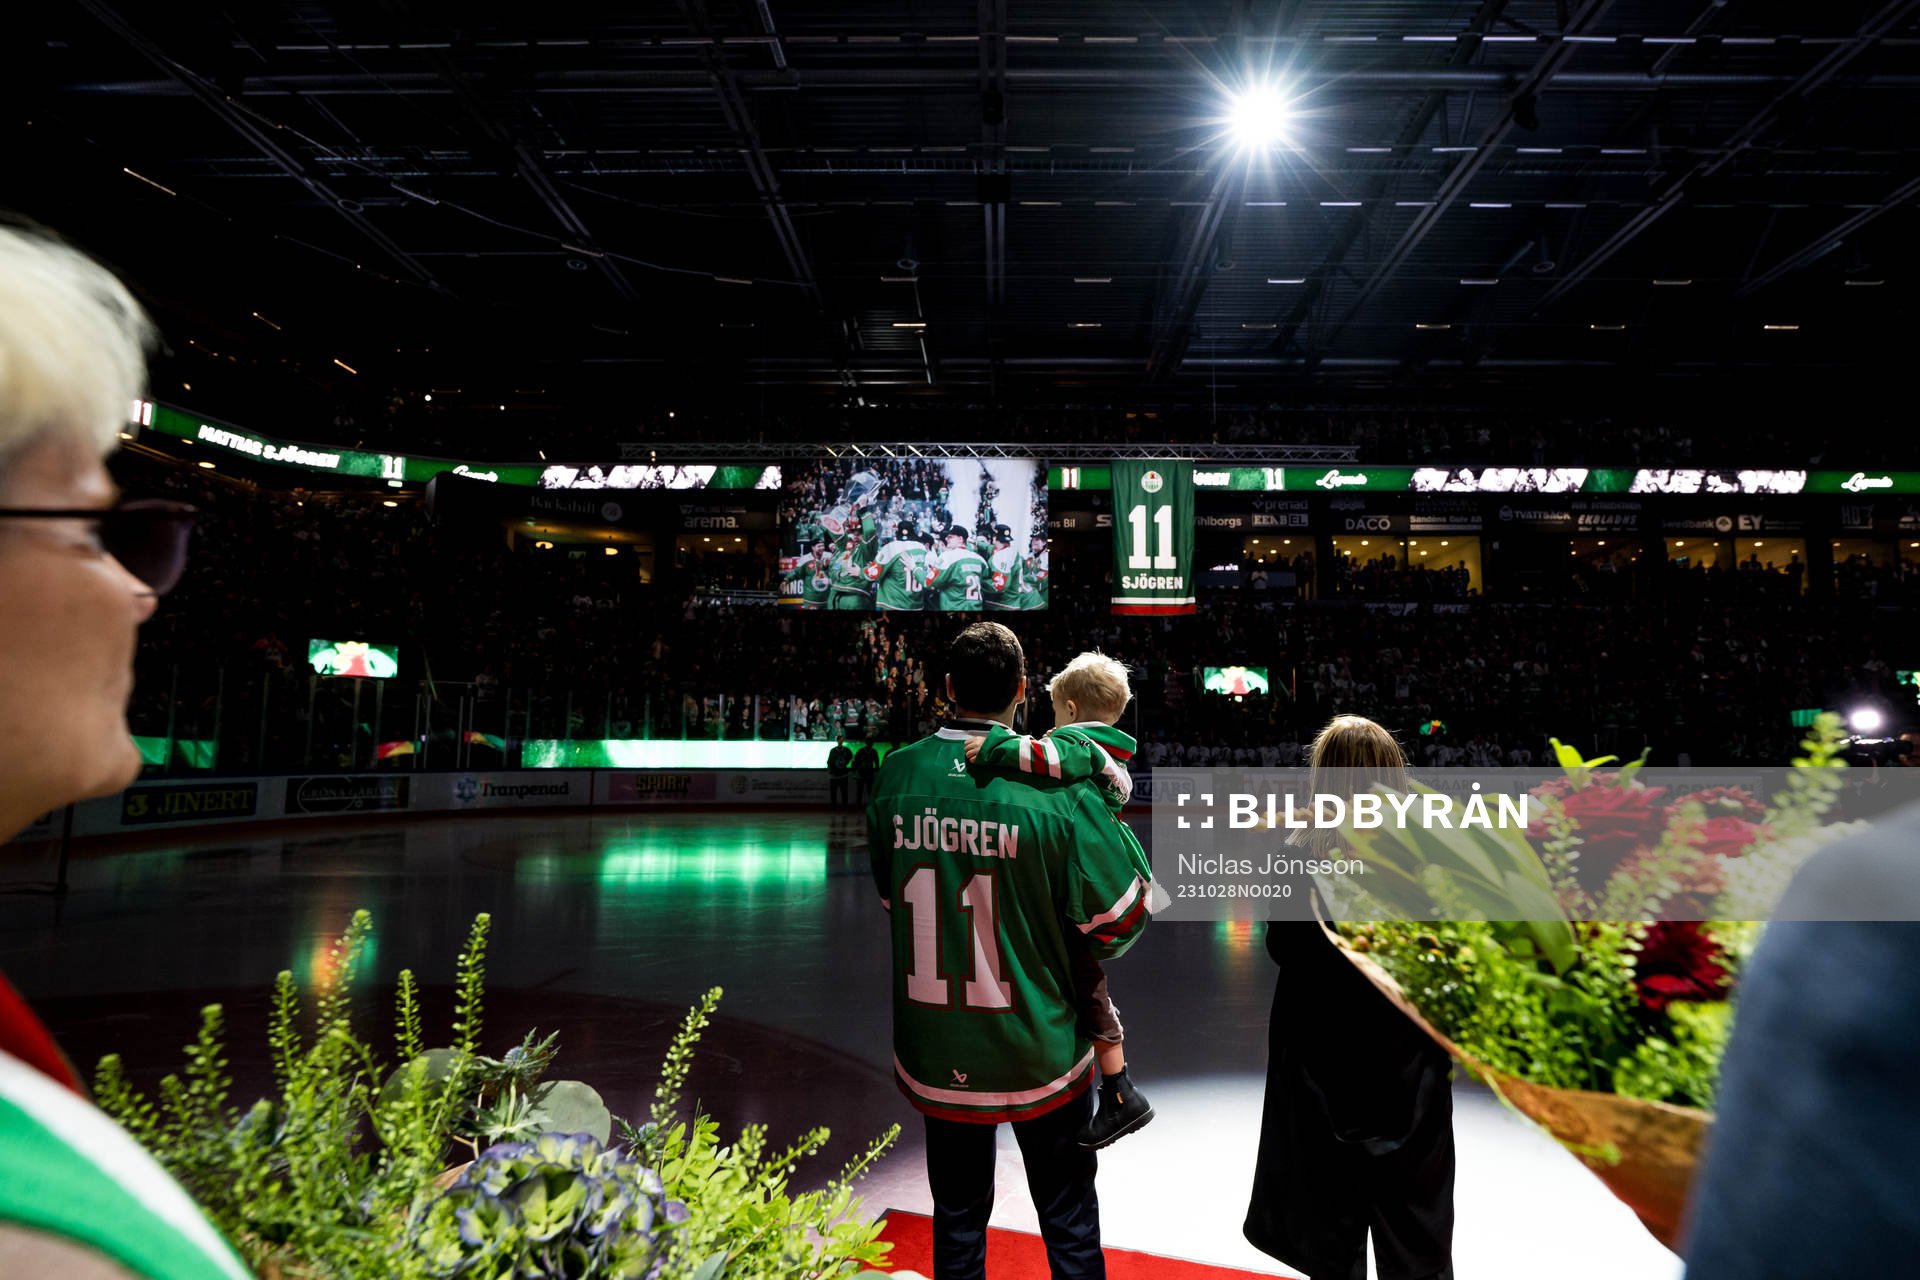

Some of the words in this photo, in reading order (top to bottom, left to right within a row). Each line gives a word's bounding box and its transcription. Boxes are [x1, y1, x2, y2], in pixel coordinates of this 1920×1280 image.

[197, 424, 262, 456] MATTIAS
[262, 444, 340, 468] SJÖGREN
[1062, 518, 1076, 528] Bil
[1193, 515, 1243, 528] ihlborgs
[1345, 517, 1391, 531] DACO
[1737, 514, 1763, 531] EY
[1128, 504, 1178, 569] 11
[1121, 572, 1184, 590] SJÖGREN
[892, 807, 1019, 859] SJÖGREN
[901, 864, 1015, 1011] 11
